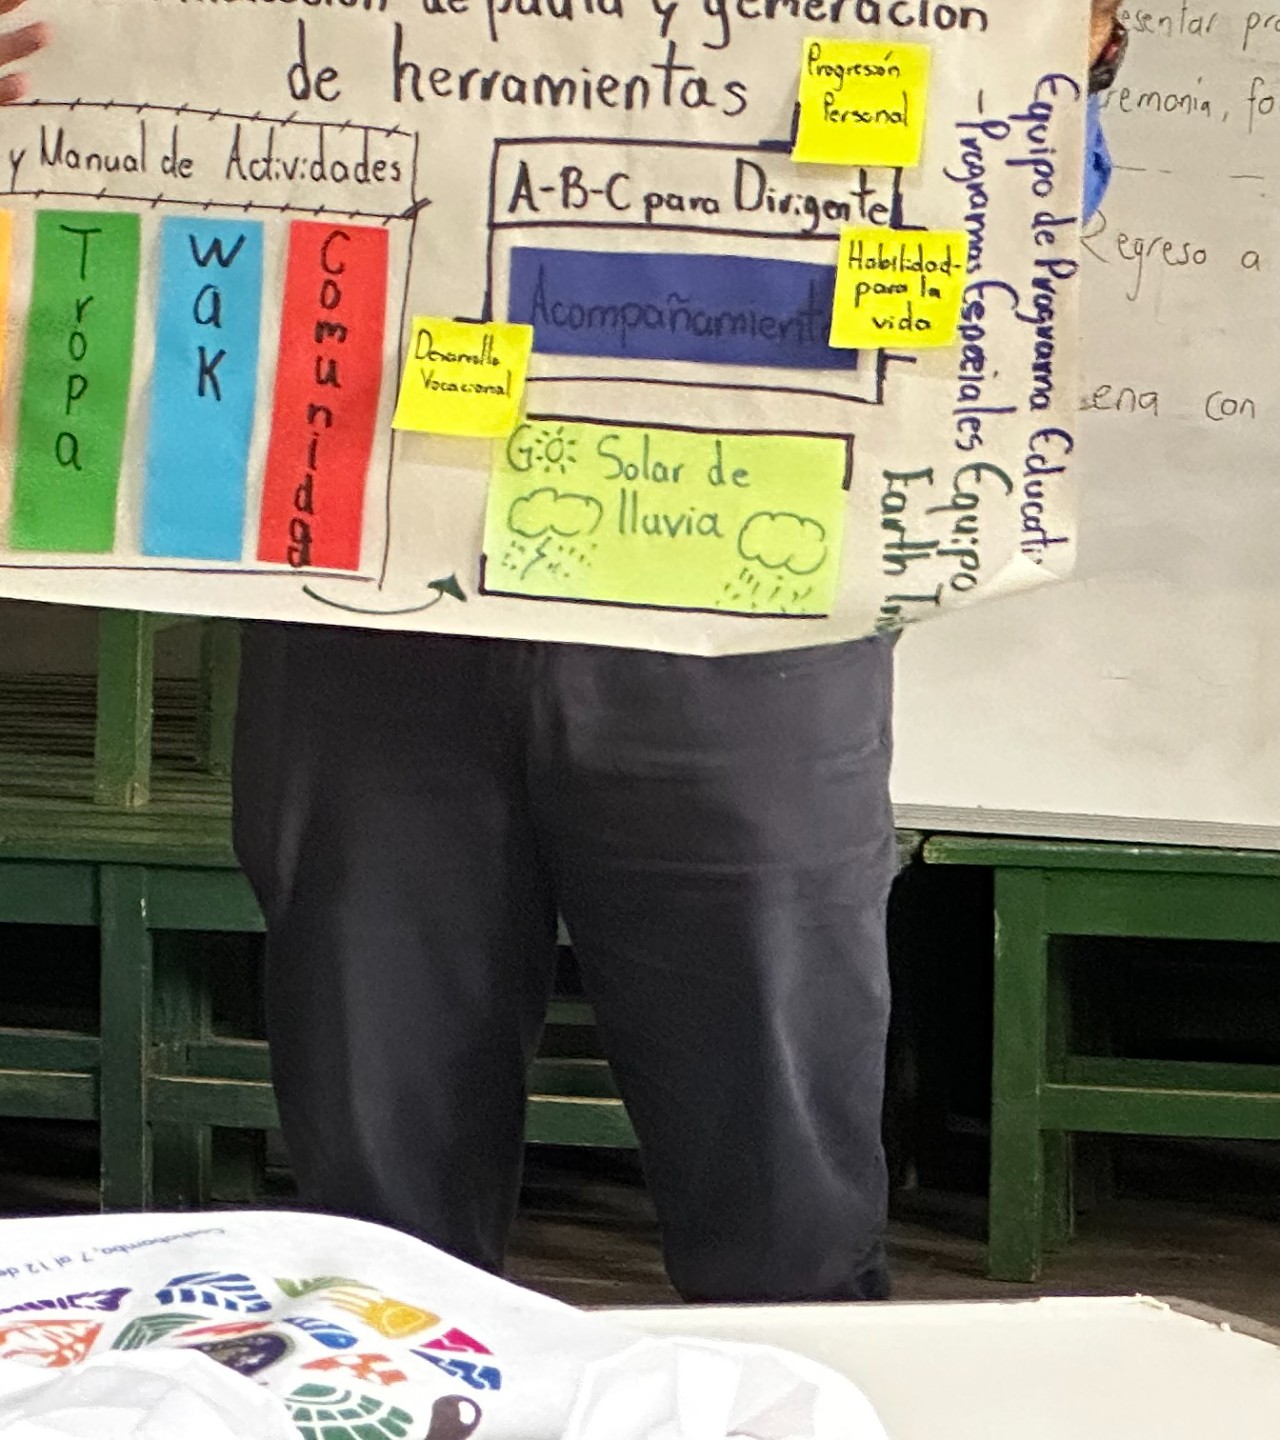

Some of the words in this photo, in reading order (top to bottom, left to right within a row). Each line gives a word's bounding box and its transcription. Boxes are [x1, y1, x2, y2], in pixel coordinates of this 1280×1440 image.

[288, 18, 341, 103] de
[393, 21, 748, 116] herramientas
[824, 91, 908, 127] Personal
[9, 149, 27, 193] y
[40, 122, 147, 173] Manual
[160, 124, 193, 179] de
[225, 123, 402, 184] Actividades
[1005, 73, 1080, 198] Equipo
[643, 192, 720, 223] para
[1032, 212, 1078, 246] de
[1242, 250, 1260, 270] a
[855, 282, 908, 308] para
[921, 274, 941, 299] la
[872, 301, 931, 331] vida
[52, 225, 102, 471] Tropa
[1015, 259, 1079, 411] Programa
[1080, 384, 1159, 416] ena
[596, 434, 684, 484] Solar
[708, 439, 751, 488] de
[618, 488, 724, 539] lluvia
[881, 467, 940, 575] Earth
[925, 462, 1014, 592] Equipo
